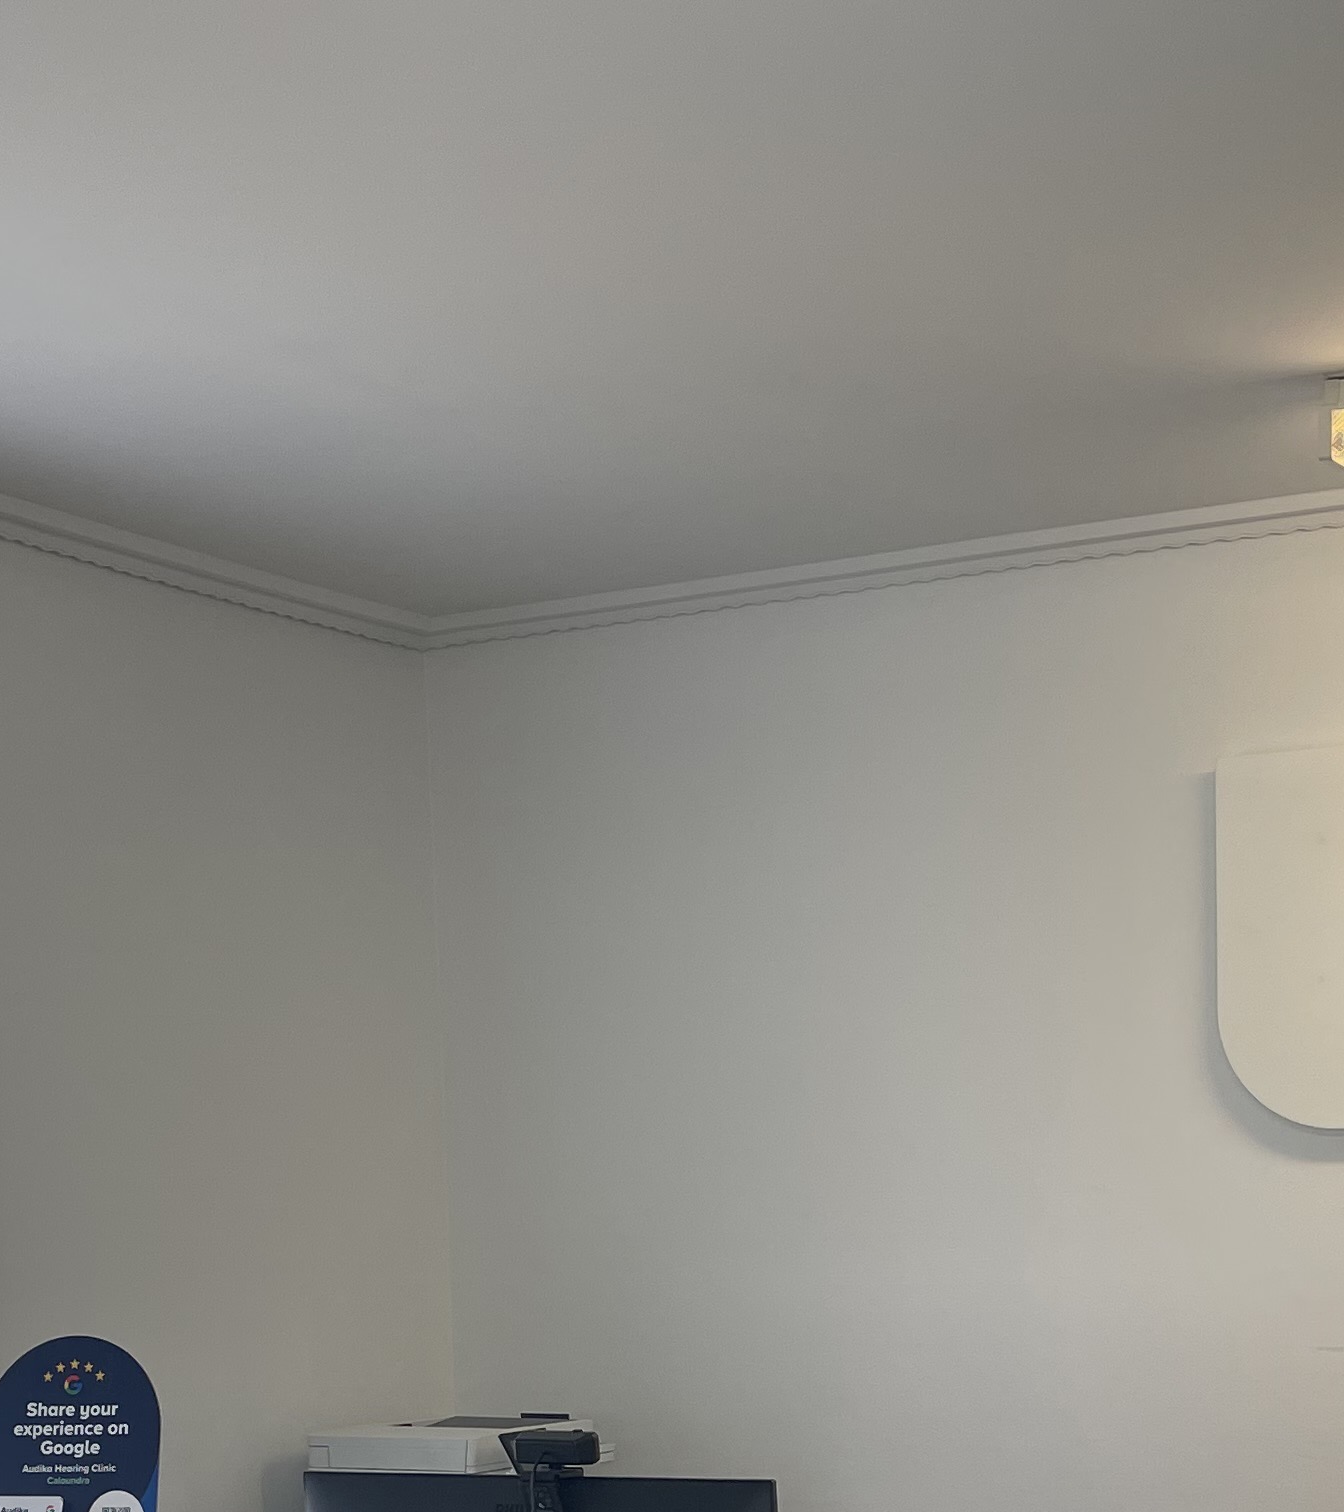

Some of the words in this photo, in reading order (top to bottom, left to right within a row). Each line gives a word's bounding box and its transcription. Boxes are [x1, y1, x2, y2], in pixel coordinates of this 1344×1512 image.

[26, 1402, 76, 1417] Share
[79, 1404, 119, 1420] your
[13, 1420, 104, 1439] experience
[107, 1423, 129, 1435] on
[40, 1440, 101, 1458] Google
[22, 1464, 53, 1473] Audika
[54, 1464, 89, 1475] Hearing
[91, 1463, 117, 1473] Clinic
